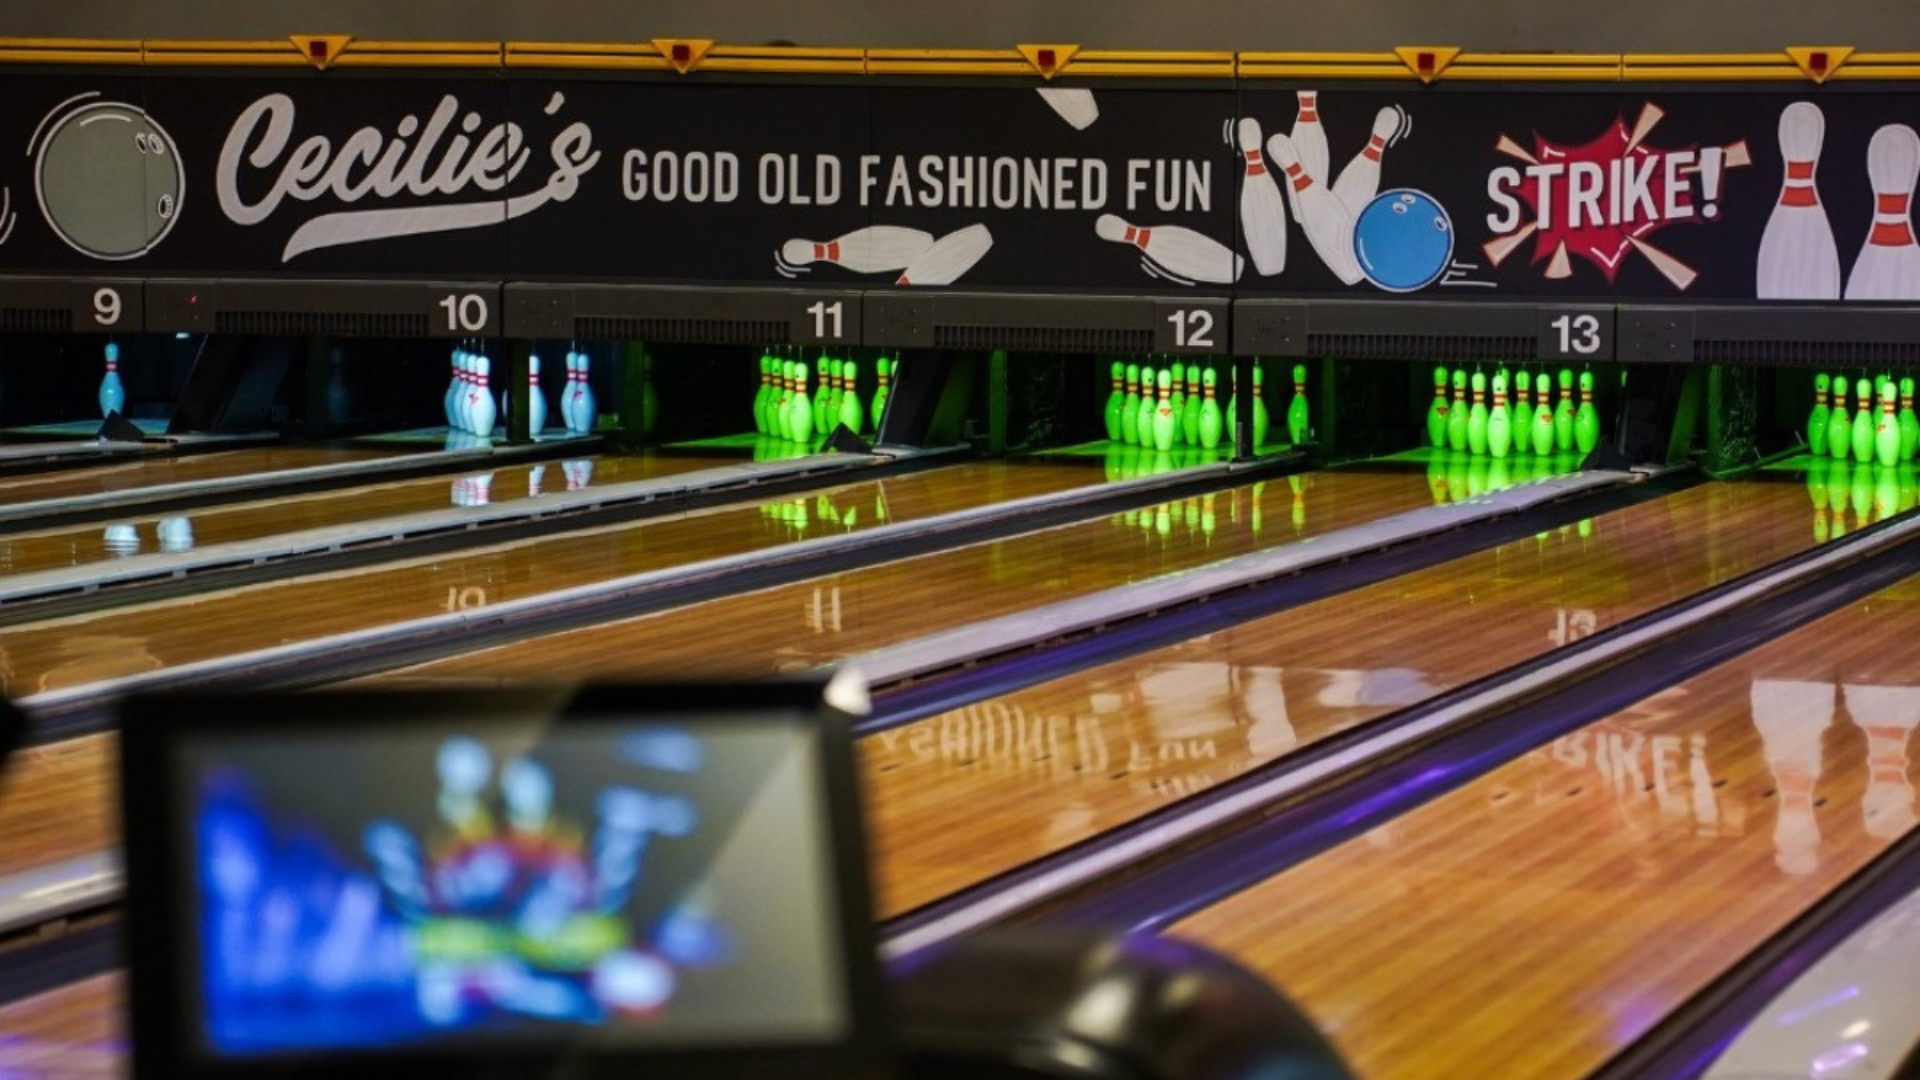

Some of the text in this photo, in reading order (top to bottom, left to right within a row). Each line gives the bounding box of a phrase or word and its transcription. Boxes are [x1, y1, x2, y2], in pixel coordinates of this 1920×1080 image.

[216, 91, 601, 225] Cecilie's
[621, 149, 1212, 213] GOOD OLD FASHIONED FUN
[1486, 147, 1724, 234] STRIKE!
[93, 288, 121, 325] 9
[439, 294, 488, 331] 10
[807, 302, 843, 338] 11
[1167, 310, 1214, 347] 12
[1551, 315, 1600, 354] 13
